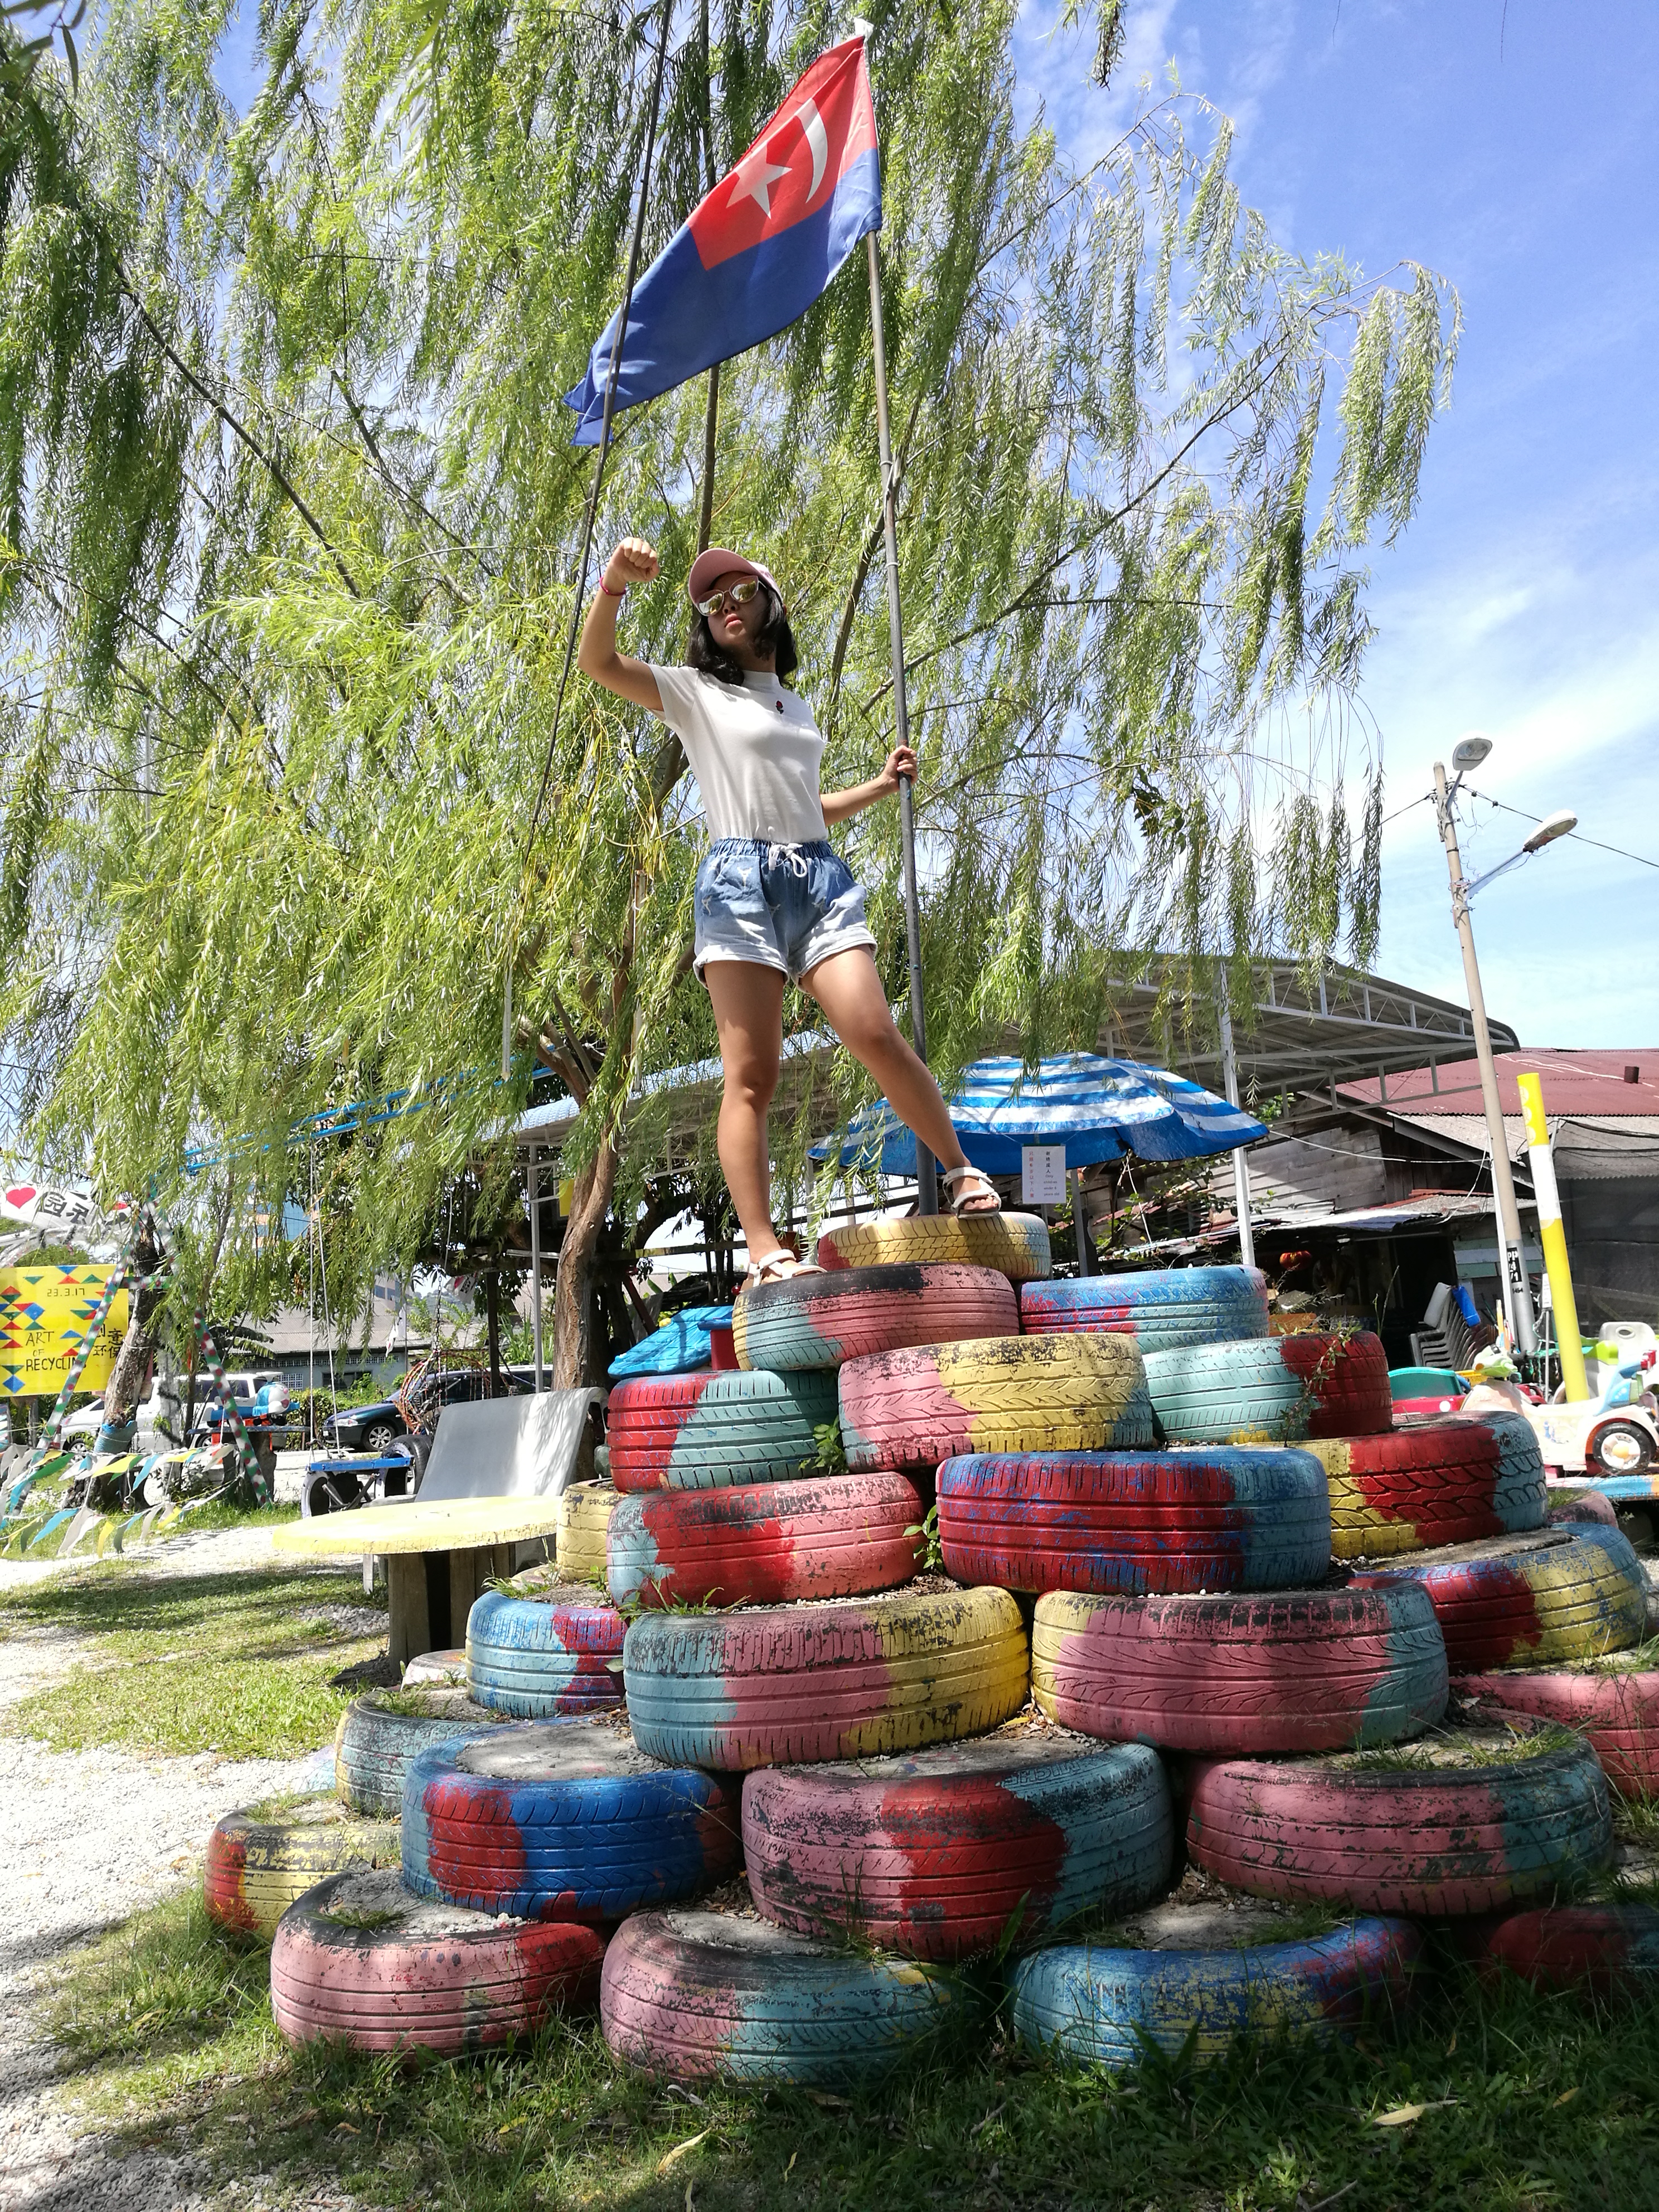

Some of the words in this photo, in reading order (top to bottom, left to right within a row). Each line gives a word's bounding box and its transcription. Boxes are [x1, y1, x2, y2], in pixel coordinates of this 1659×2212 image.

[47, 1288, 85, 1297] 23.3.17
[26, 1331, 54, 1346] ART
[33, 1348, 45, 1357] OF
[26, 1357, 86, 1372] RECYCLI
